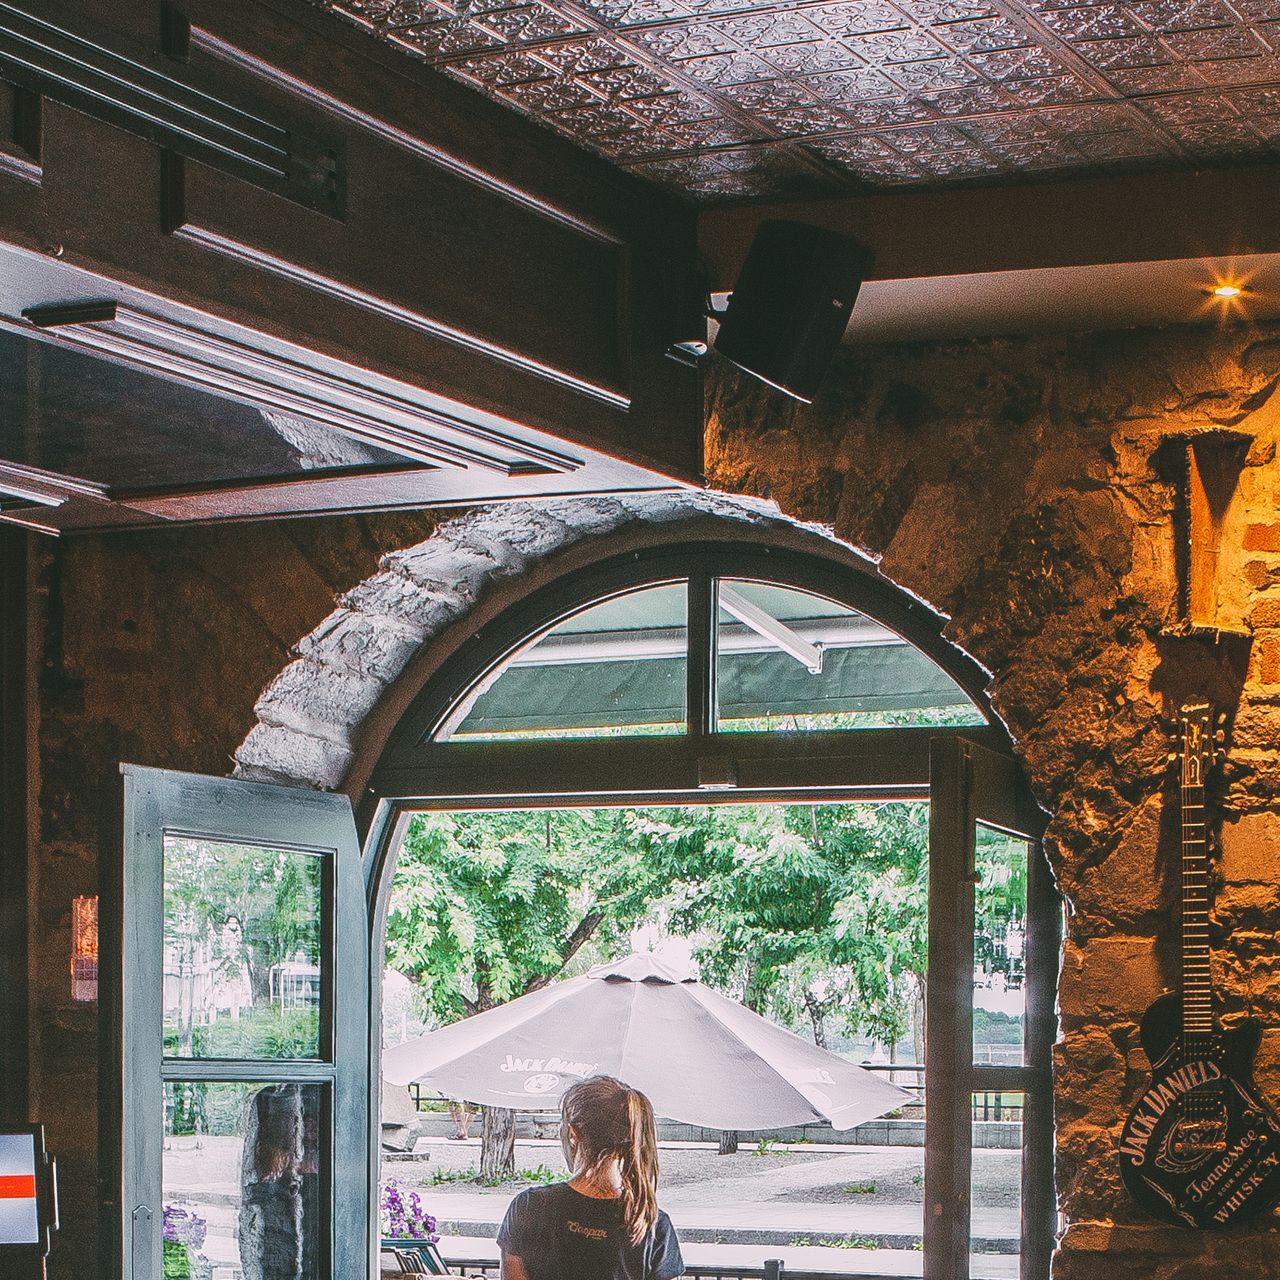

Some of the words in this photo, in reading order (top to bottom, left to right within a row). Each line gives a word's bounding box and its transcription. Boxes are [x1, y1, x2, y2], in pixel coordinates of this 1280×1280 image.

[1120, 1109, 1159, 1166] JACK
[1186, 1130, 1258, 1202] Tennessee
[1214, 1152, 1280, 1223] WHISKY
